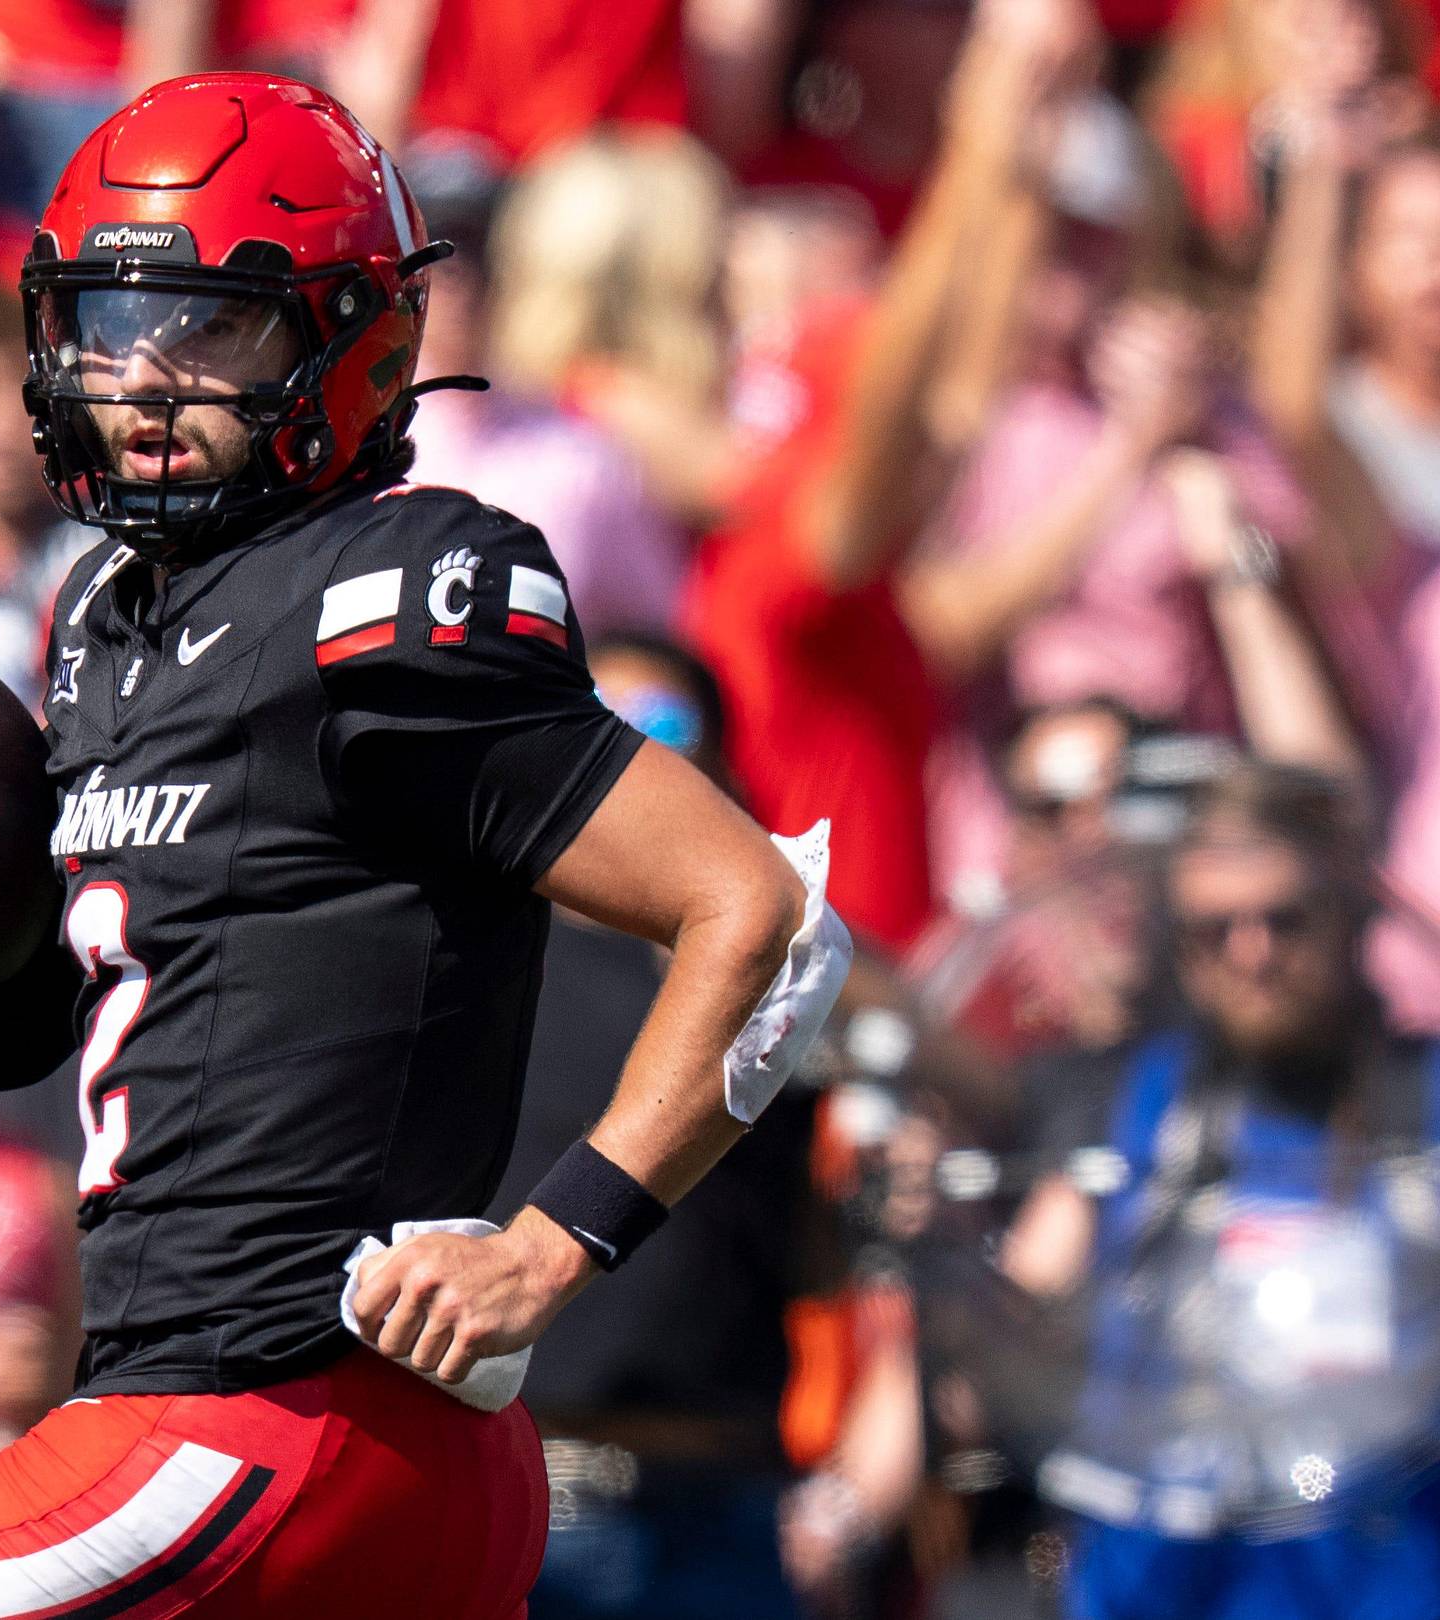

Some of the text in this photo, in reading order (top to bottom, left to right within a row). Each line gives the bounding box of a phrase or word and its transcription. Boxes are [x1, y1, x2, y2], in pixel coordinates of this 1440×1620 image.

[94, 228, 176, 249] CINCINNATI
[427, 556, 474, 626] C
[66, 880, 151, 1198] 2
